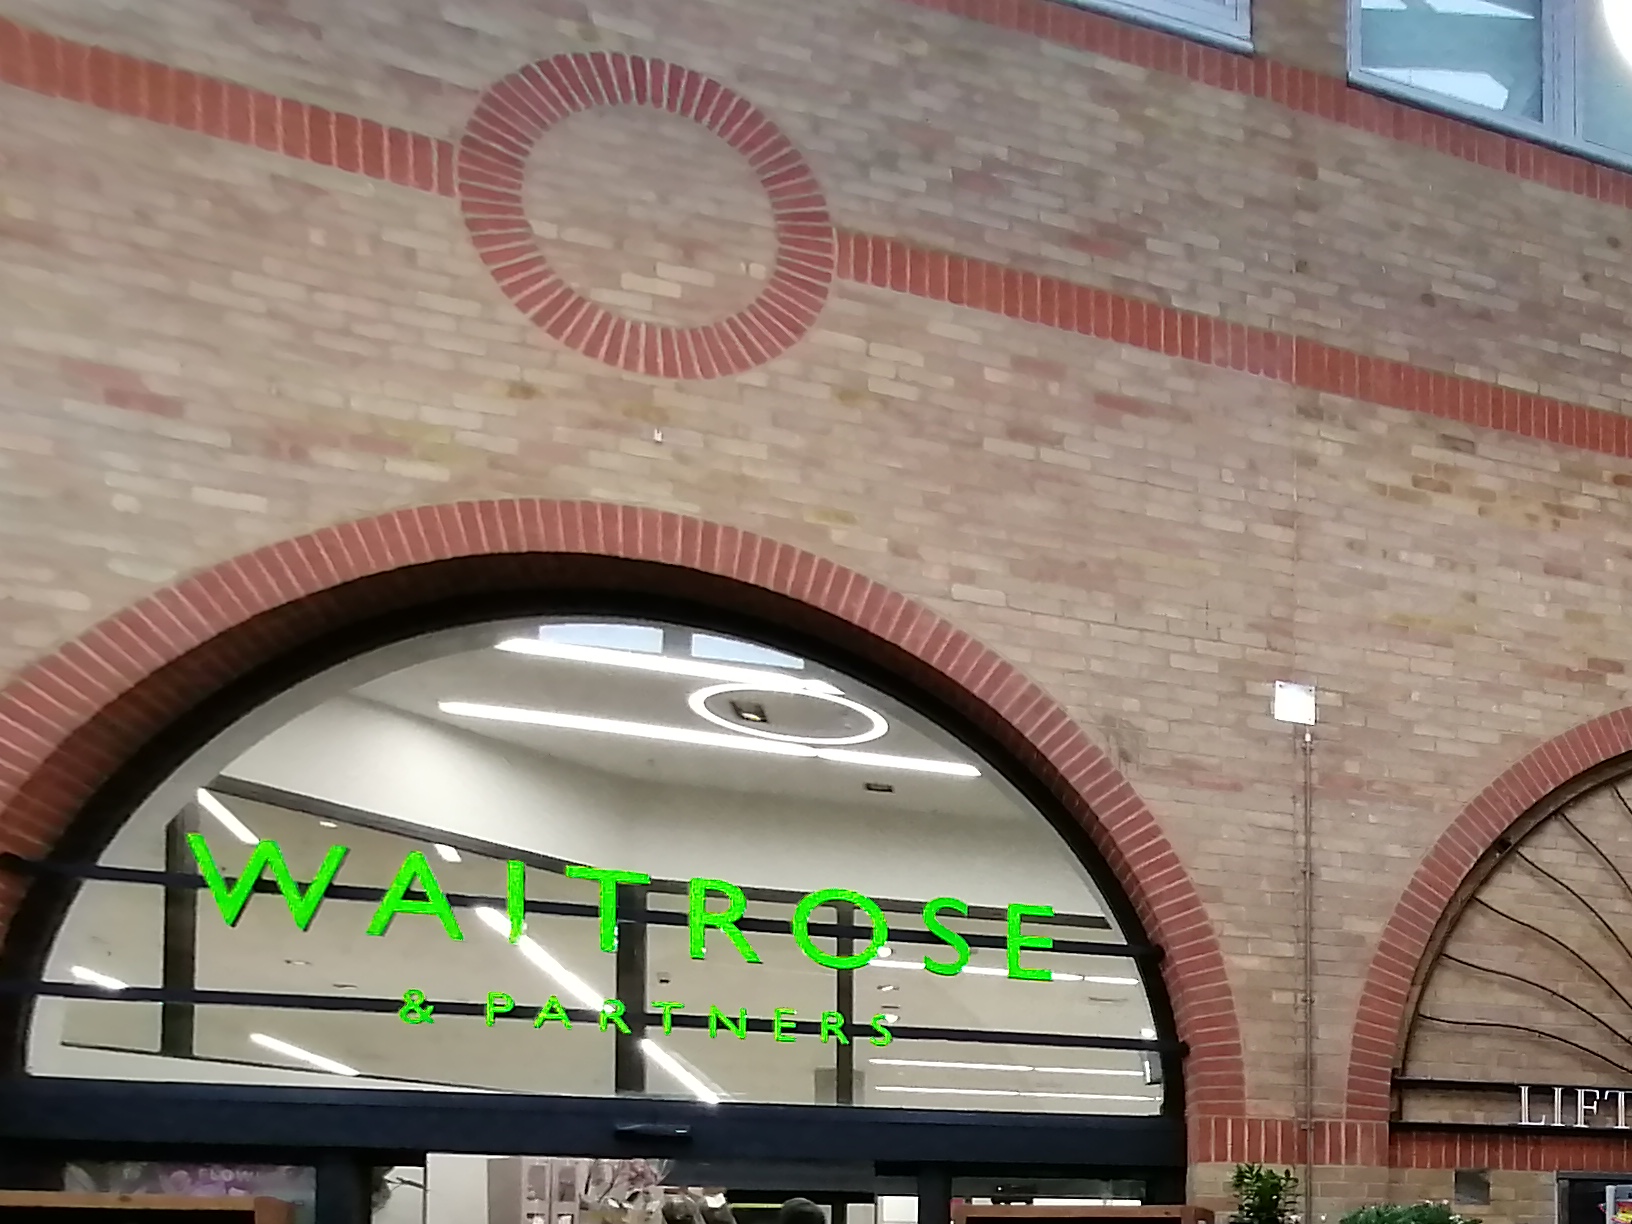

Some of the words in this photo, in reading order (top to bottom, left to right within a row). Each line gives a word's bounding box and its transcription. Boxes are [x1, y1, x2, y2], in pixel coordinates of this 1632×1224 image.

[187, 833, 1056, 981] WAITROSE
[399, 988, 435, 1025] &
[485, 991, 894, 1047] PARTNERS
